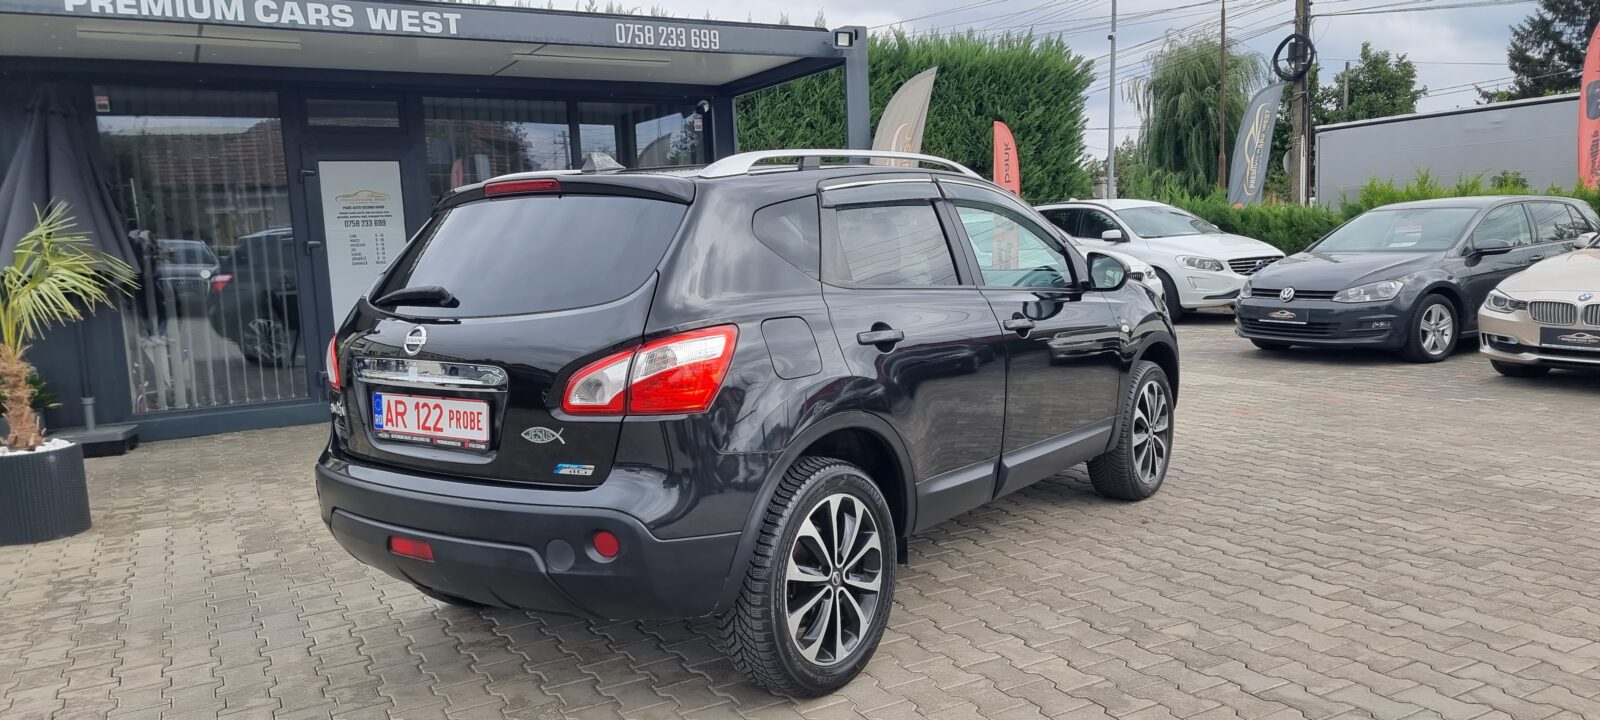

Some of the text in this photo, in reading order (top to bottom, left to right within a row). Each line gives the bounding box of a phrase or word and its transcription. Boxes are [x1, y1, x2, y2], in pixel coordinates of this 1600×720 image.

[64, 0, 461, 34] PREMIUM CARS WEST
[615, 23, 719, 49] 0758 233 699
[361, 219, 372, 227] 233
[374, 219, 386, 227] 699
[385, 399, 483, 432] AR 122 PROBE
[526, 429, 553, 441] JESUS
